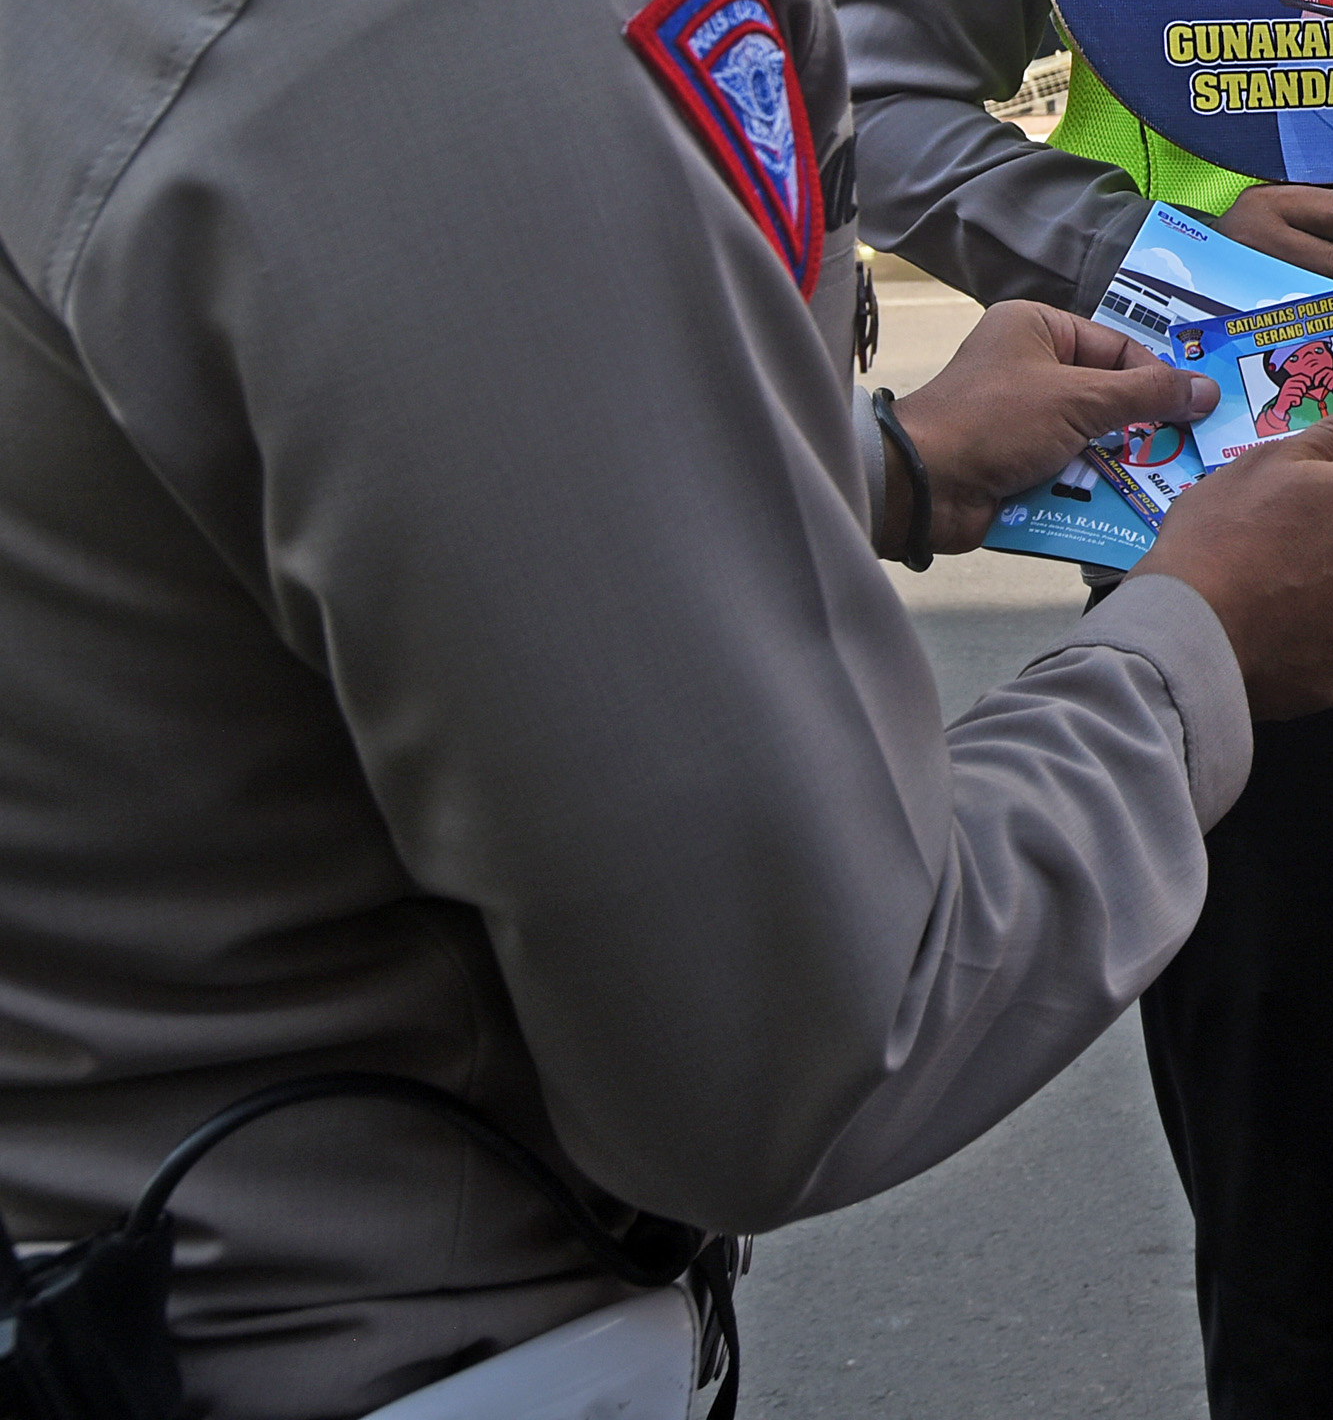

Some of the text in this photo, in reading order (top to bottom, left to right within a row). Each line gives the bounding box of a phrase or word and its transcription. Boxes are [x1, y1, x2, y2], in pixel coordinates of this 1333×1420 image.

[1157, 210, 1208, 241] BUMN
[1225, 307, 1295, 335] SATLANTAS
[1253, 322, 1304, 347] SERANG
[1107, 459, 1140, 492] MAUNG
[1137, 492, 1160, 515] 2022
[1147, 472, 1176, 498] SAAT
[1032, 509, 1146, 545] JASA RAHARJA
